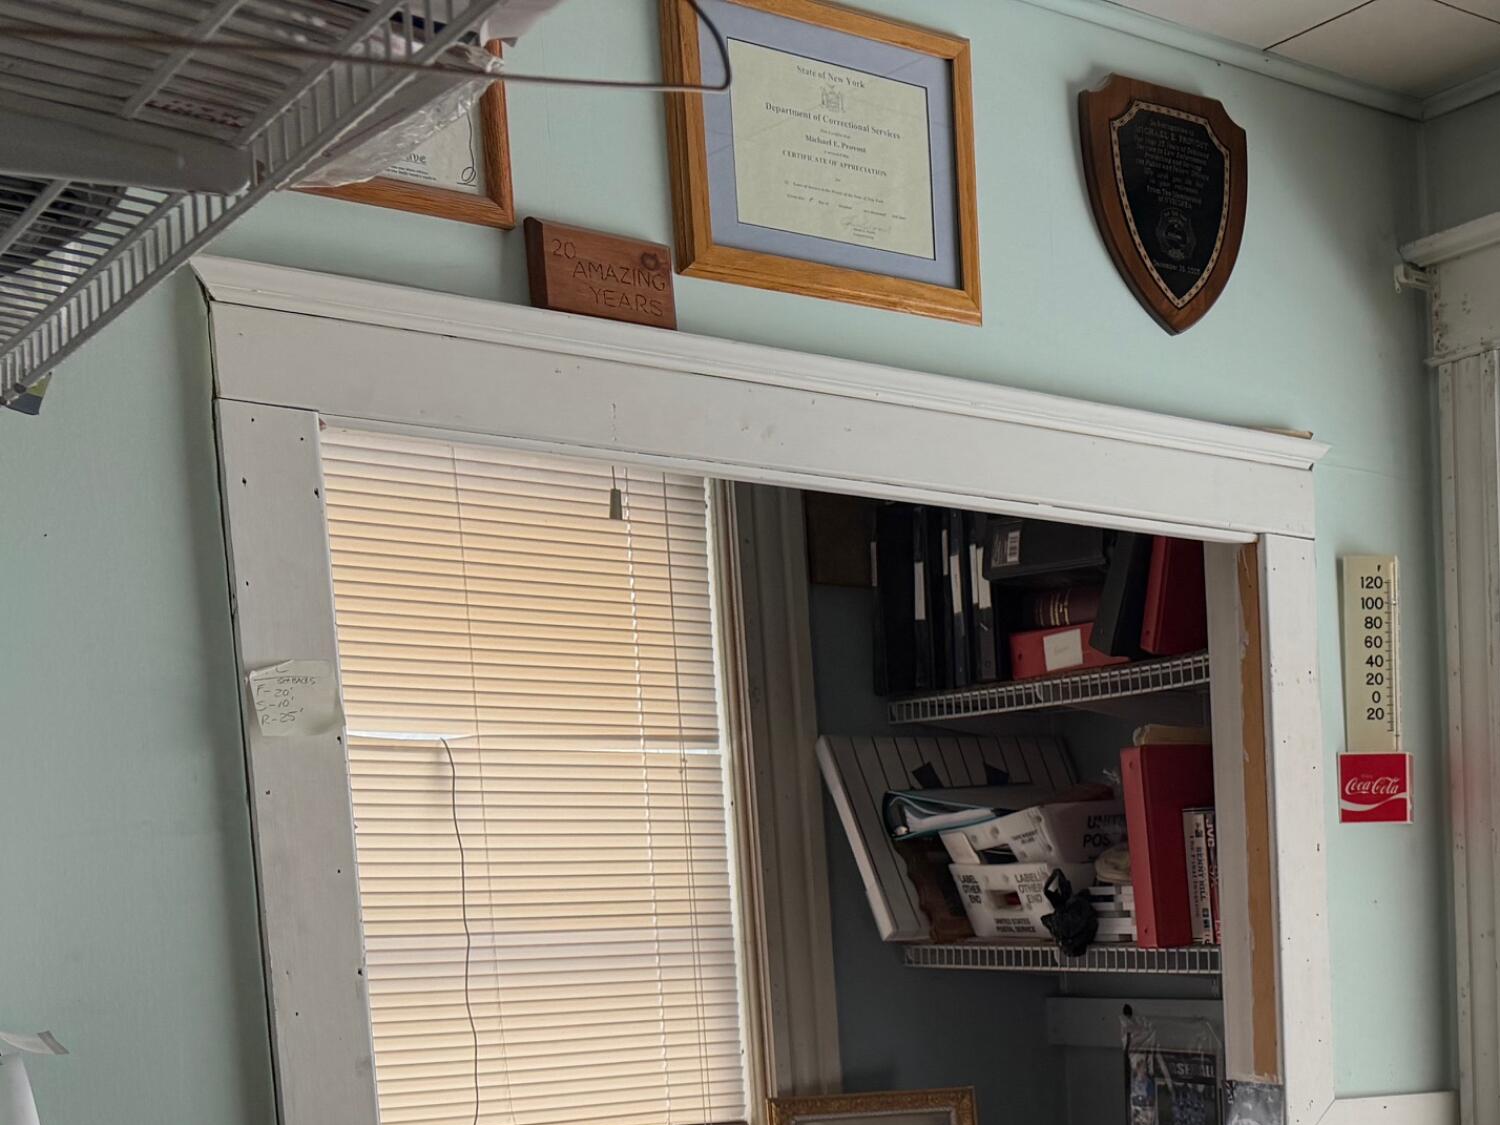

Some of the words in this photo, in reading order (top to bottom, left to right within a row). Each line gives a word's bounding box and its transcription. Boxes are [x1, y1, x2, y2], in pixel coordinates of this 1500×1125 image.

[796, 65, 817, 79] State
[828, 73, 844, 83] New
[846, 77, 865, 89] York
[765, 102, 811, 122] Department
[812, 112, 821, 121] of
[822, 114, 870, 134] Correctional
[871, 125, 901, 140] Services
[782, 150, 828, 166] CERTIFICATE
[839, 160, 887, 177] APPRECIATION
[551, 238, 577, 259] 20
[572, 260, 666, 291] AMAZING
[589, 287, 663, 317] YEARS
[1360, 576, 1382, 589] 120
[1361, 597, 1383, 610] 100
[1364, 617, 1382, 629] 80
[1364, 636, 1383, 648] 60
[1365, 655, 1383, 667] 40
[1366, 673, 1383, 685] 20
[1372, 691, 1381, 703] 0
[1367, 708, 1384, 720] 20
[1345, 777, 1399, 795] Coca-Cola
[1206, 817, 1215, 847] JVC
[959, 875, 978, 883] LABEL
[962, 885, 981, 893] OTHER
[969, 895, 982, 904] END
